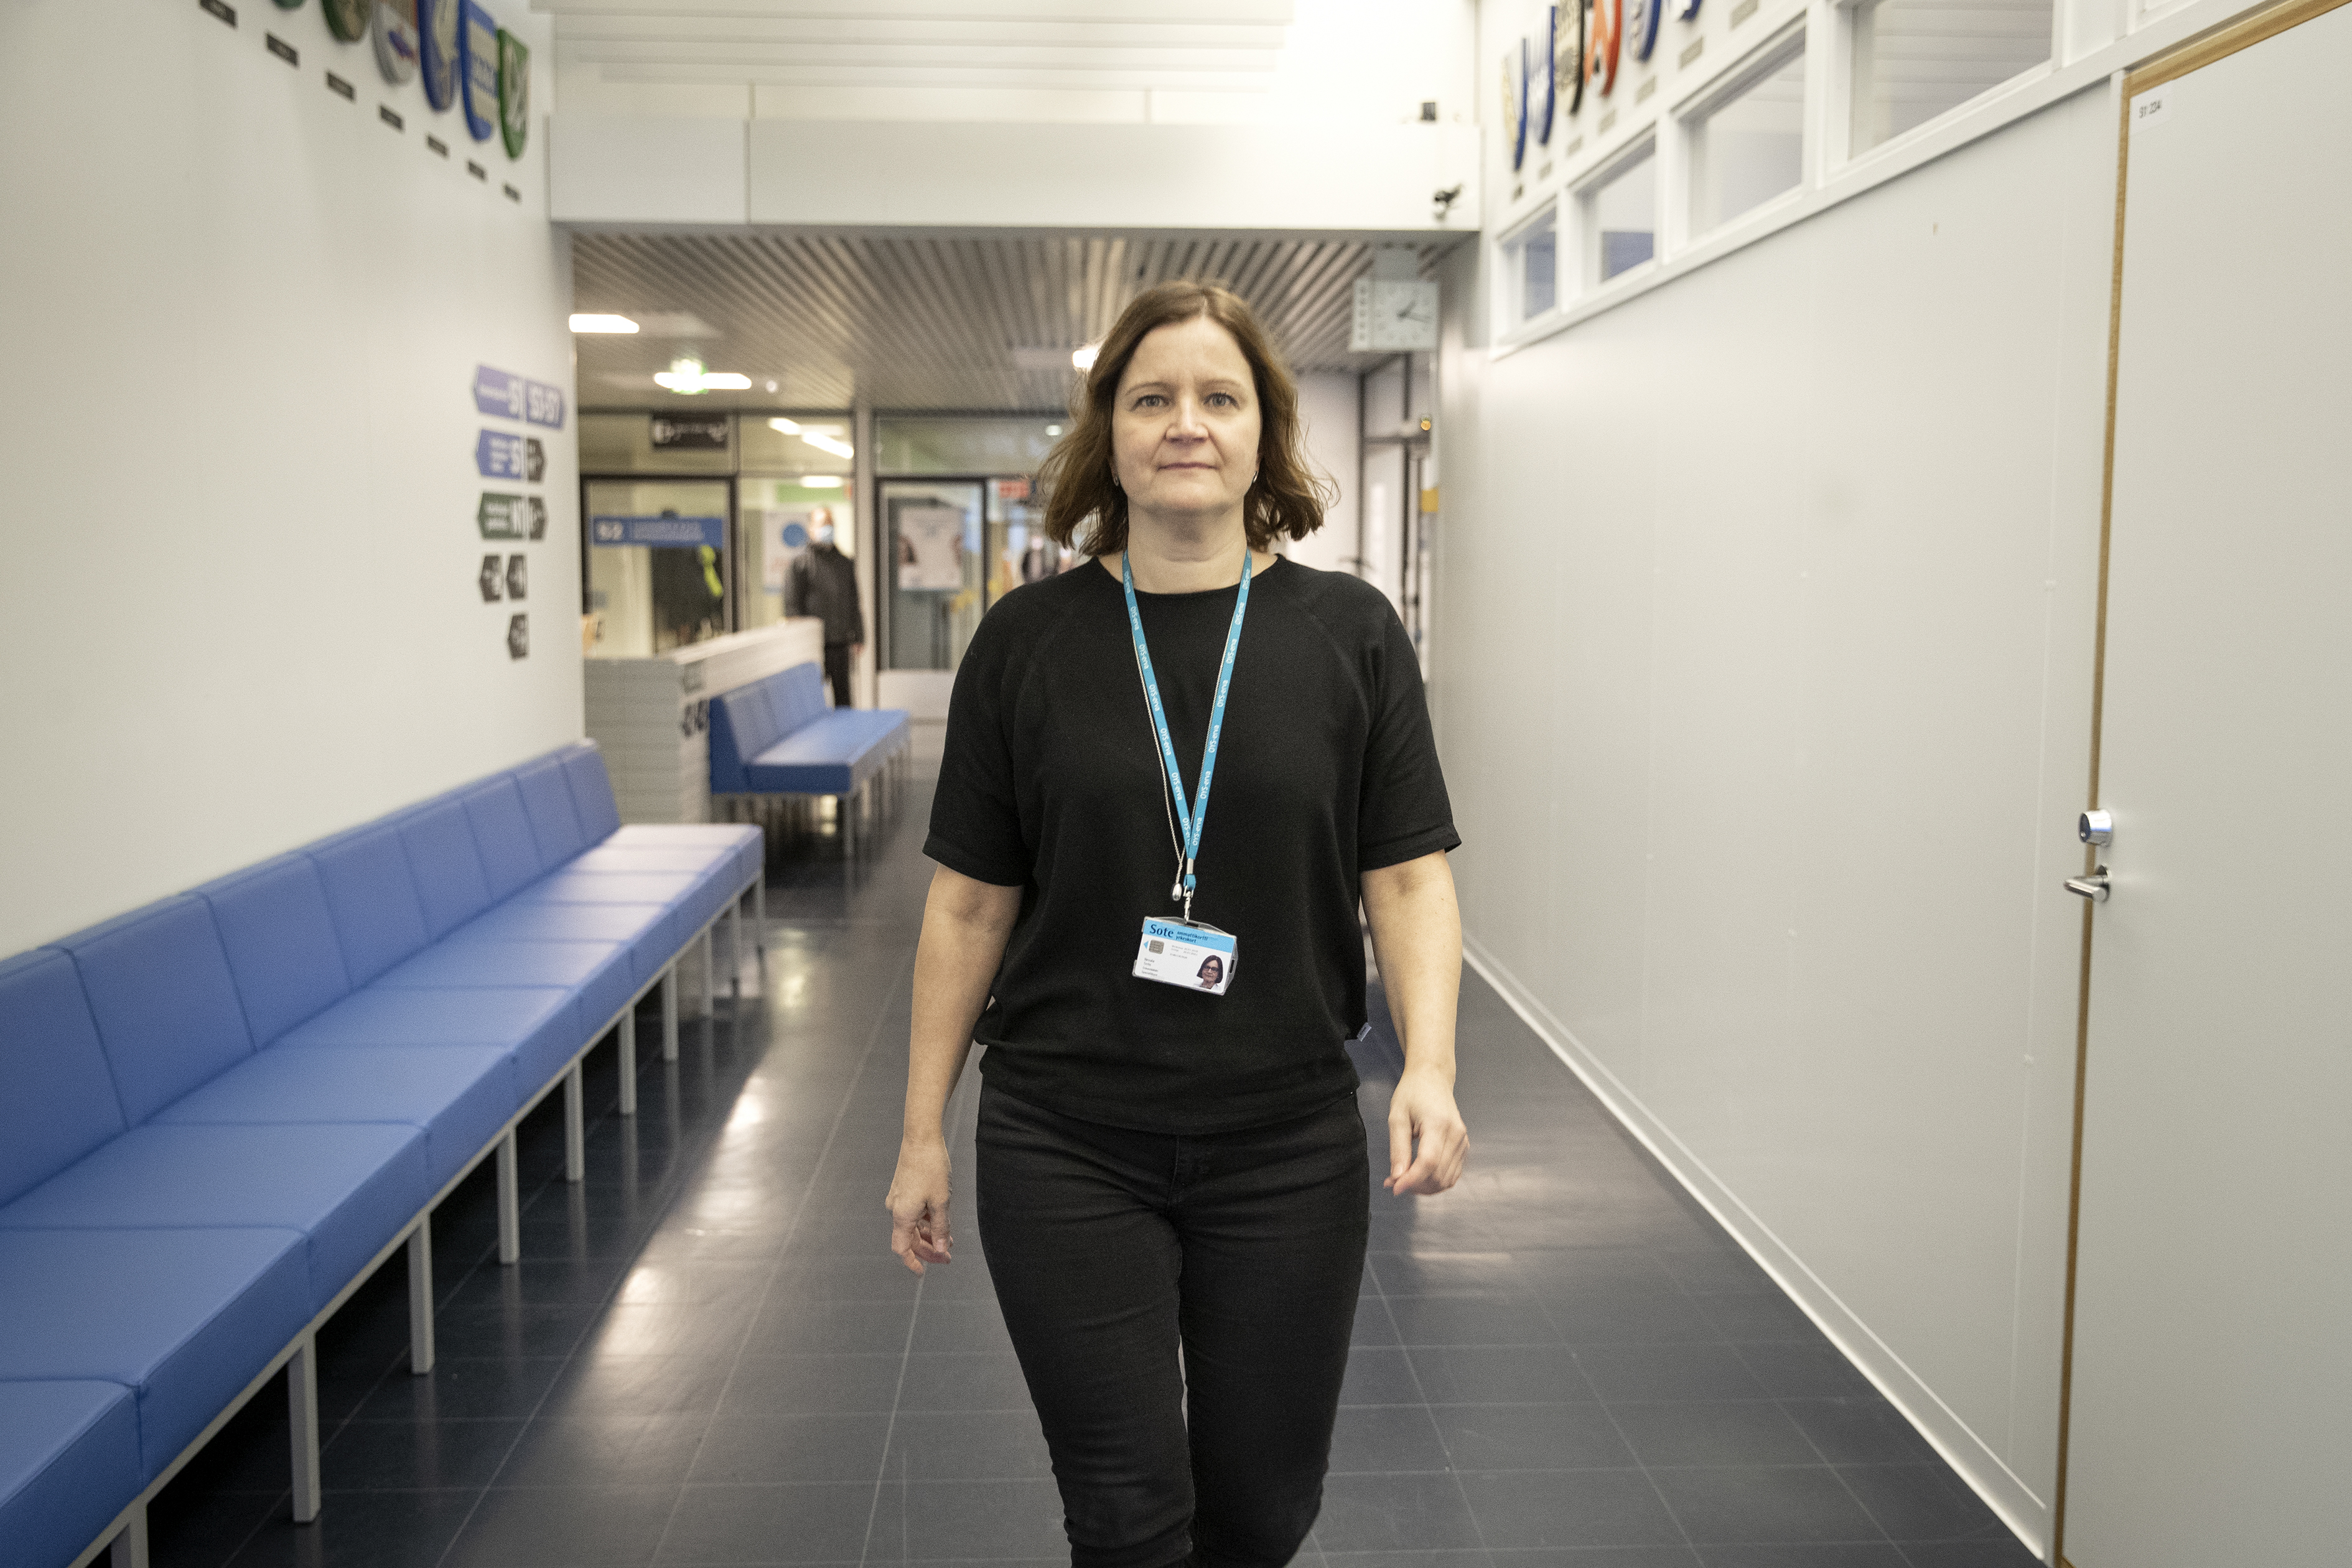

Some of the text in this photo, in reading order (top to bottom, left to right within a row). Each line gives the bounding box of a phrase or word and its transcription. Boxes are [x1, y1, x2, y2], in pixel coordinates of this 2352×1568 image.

[1149, 684, 1159, 711] OYS-erva
[1217, 680, 1228, 707] OYS-erva
[1160, 728, 1172, 755] OYS-erva
[1208, 725, 1219, 753] OYS-erva
[1171, 773, 1182, 800] OYS-erva
[1200, 771, 1211, 799] OYS-erva
[1192, 818, 1202, 846] OYS-erva
[1149, 924, 1174, 938] Sote
